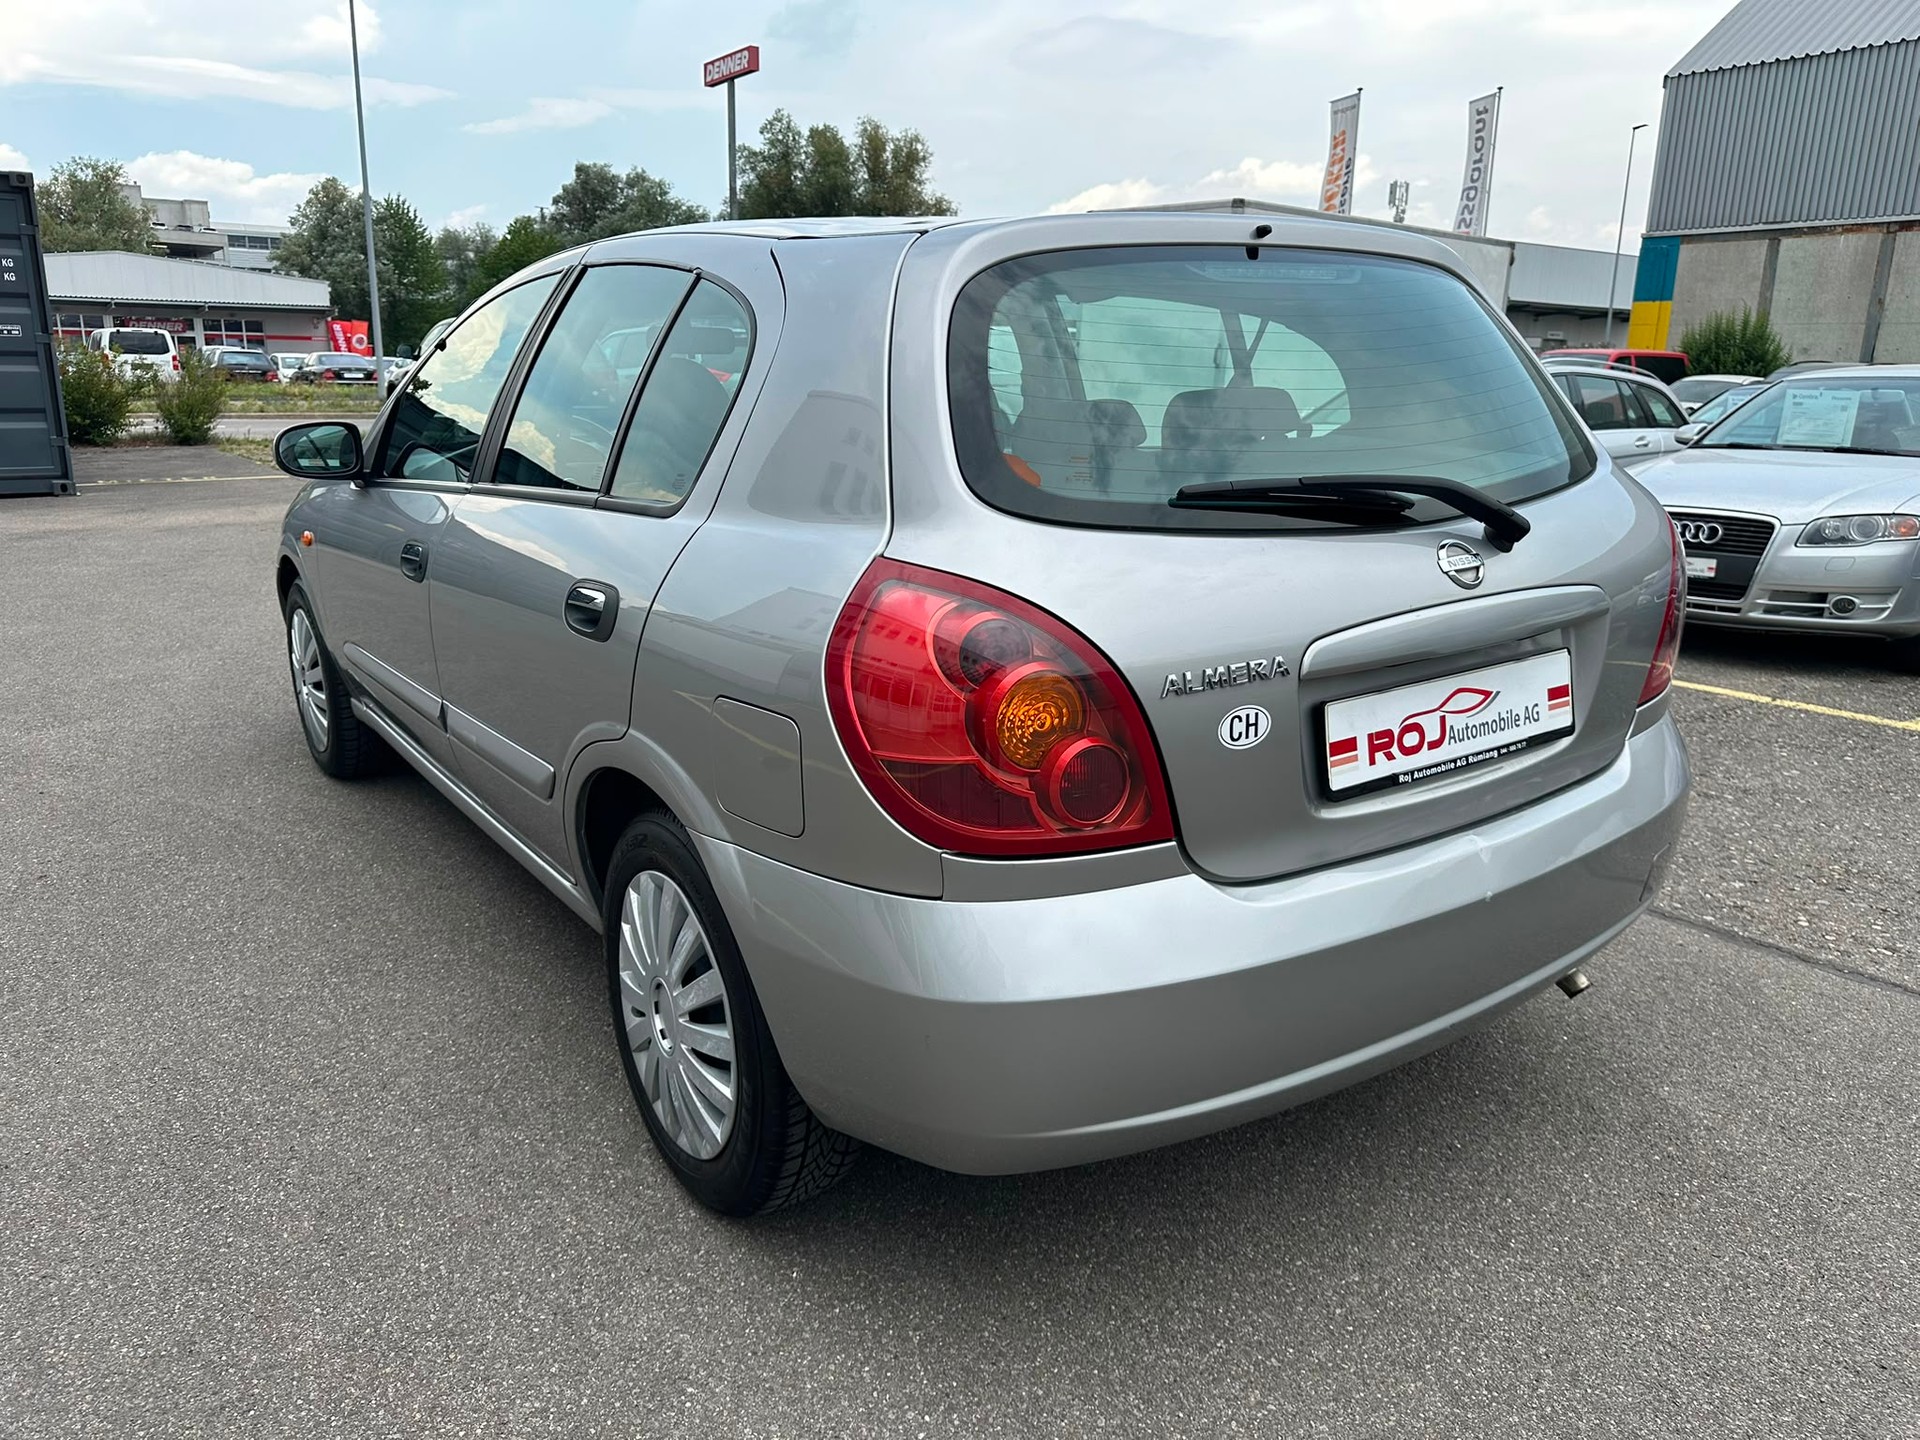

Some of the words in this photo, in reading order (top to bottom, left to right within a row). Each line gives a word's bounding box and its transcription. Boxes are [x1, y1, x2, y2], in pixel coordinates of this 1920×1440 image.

[705, 50, 749, 82] DENNER
[1, 258, 14, 267] KG
[3, 272, 16, 281] KG
[128, 320, 184, 332] DENNER
[1160, 655, 1291, 699] ALMERA
[1229, 711, 1259, 742] CH
[1367, 714, 1447, 767] ROJ
[1448, 709, 1520, 745] Automobile
[1523, 703, 1540, 725] AG
[1398, 773, 1412, 783] Roj
[1413, 762, 1455, 779] Automobile
[1456, 757, 1467, 767] AG
